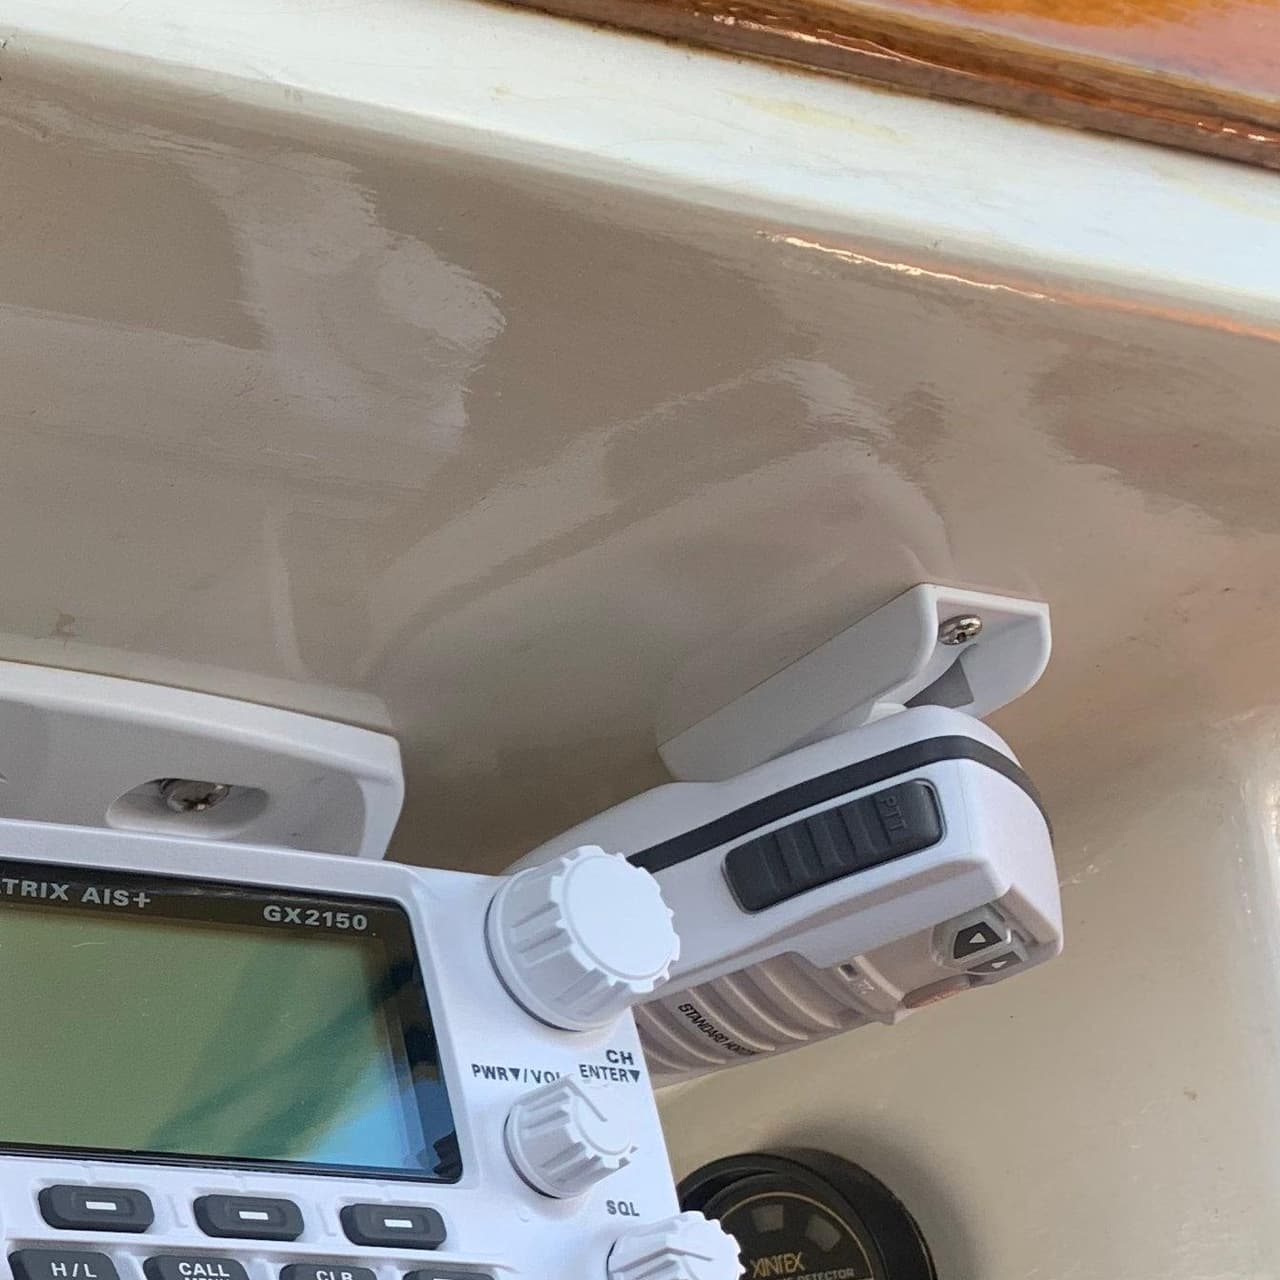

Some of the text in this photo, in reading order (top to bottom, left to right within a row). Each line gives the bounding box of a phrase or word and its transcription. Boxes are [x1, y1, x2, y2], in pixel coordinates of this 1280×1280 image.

[81, 886, 151, 909] AIS+
[263, 904, 368, 932] GX2150
[605, 1049, 634, 1066] CH
[606, 1199, 640, 1217] SQL
[178, 1261, 231, 1279] CALL
[749, 1251, 806, 1279] XINTEX
